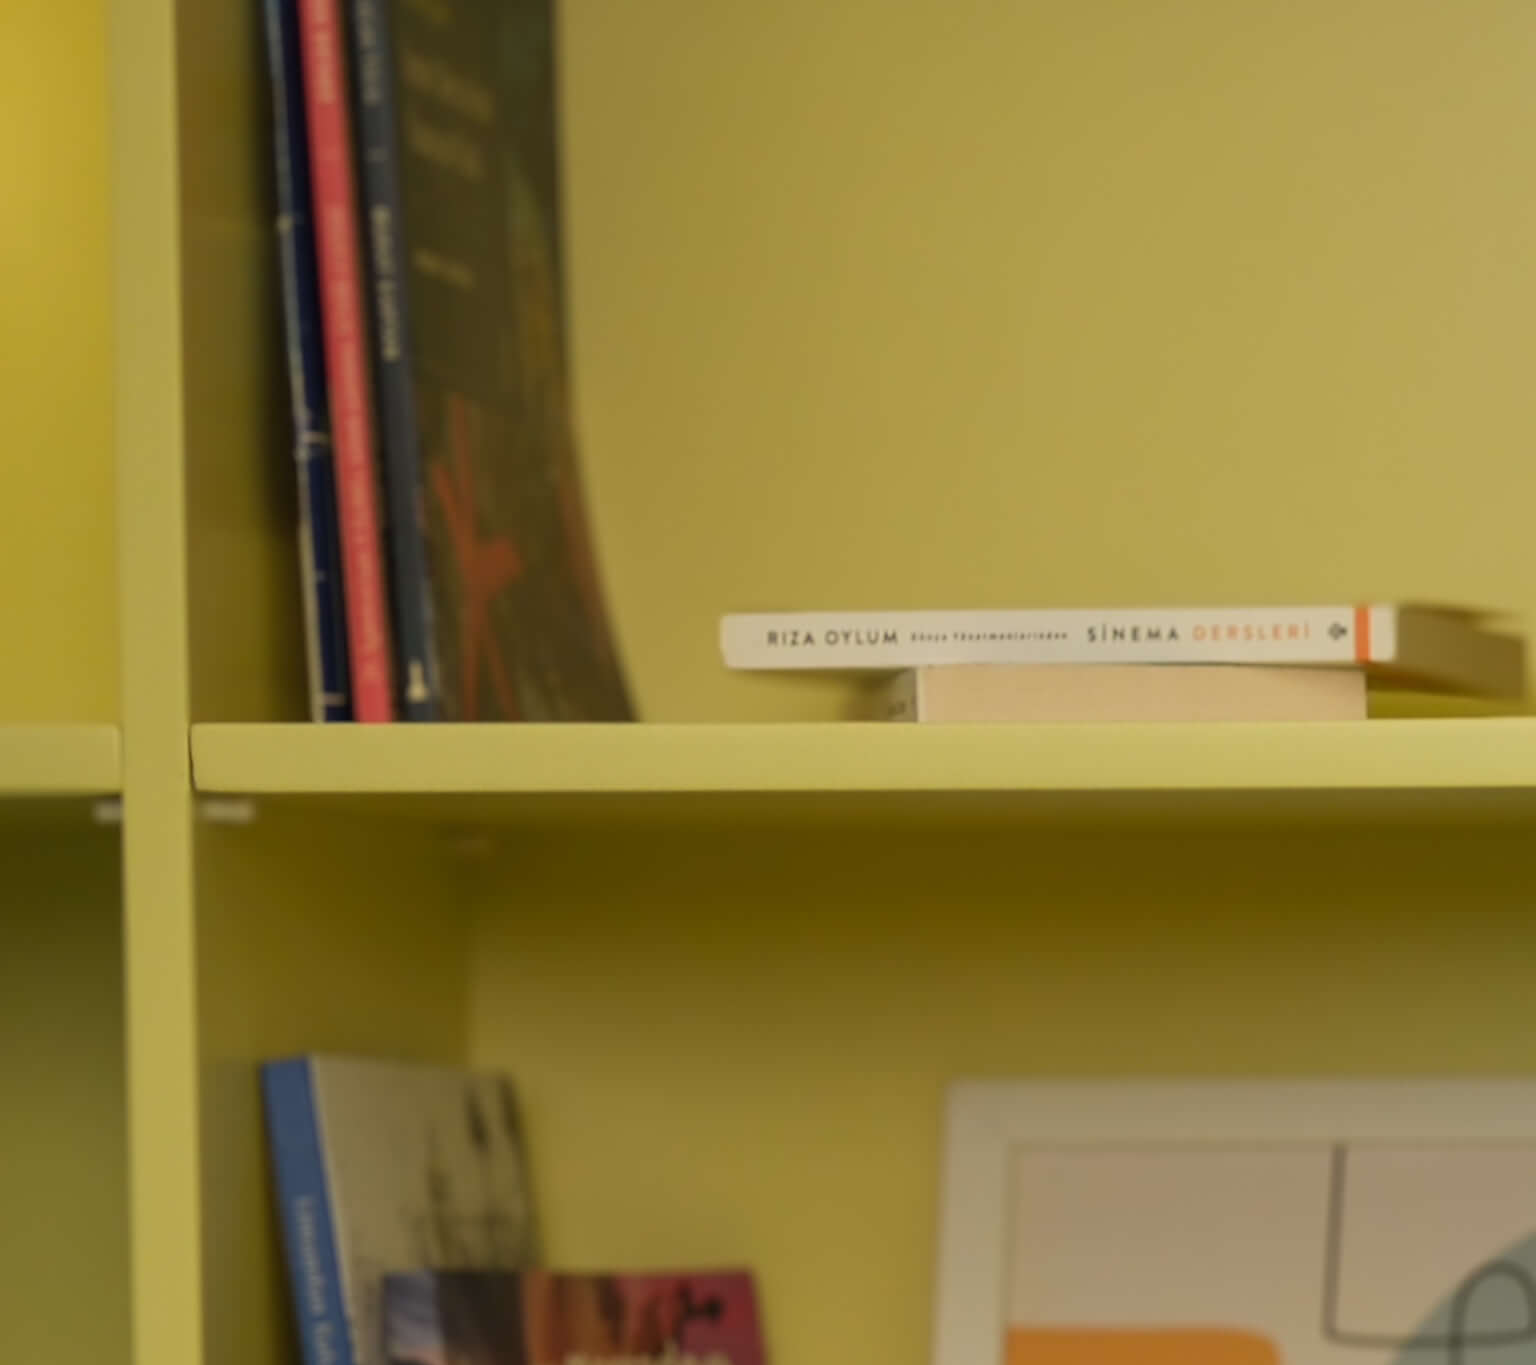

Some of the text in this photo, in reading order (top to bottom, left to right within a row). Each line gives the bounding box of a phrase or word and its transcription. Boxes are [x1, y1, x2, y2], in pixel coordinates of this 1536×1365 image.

[767, 629, 815, 646] RIZA
[824, 628, 898, 646] OYLUM
[1087, 623, 1179, 642] SİNEMA
[1192, 621, 1310, 641] DERSLERİ
